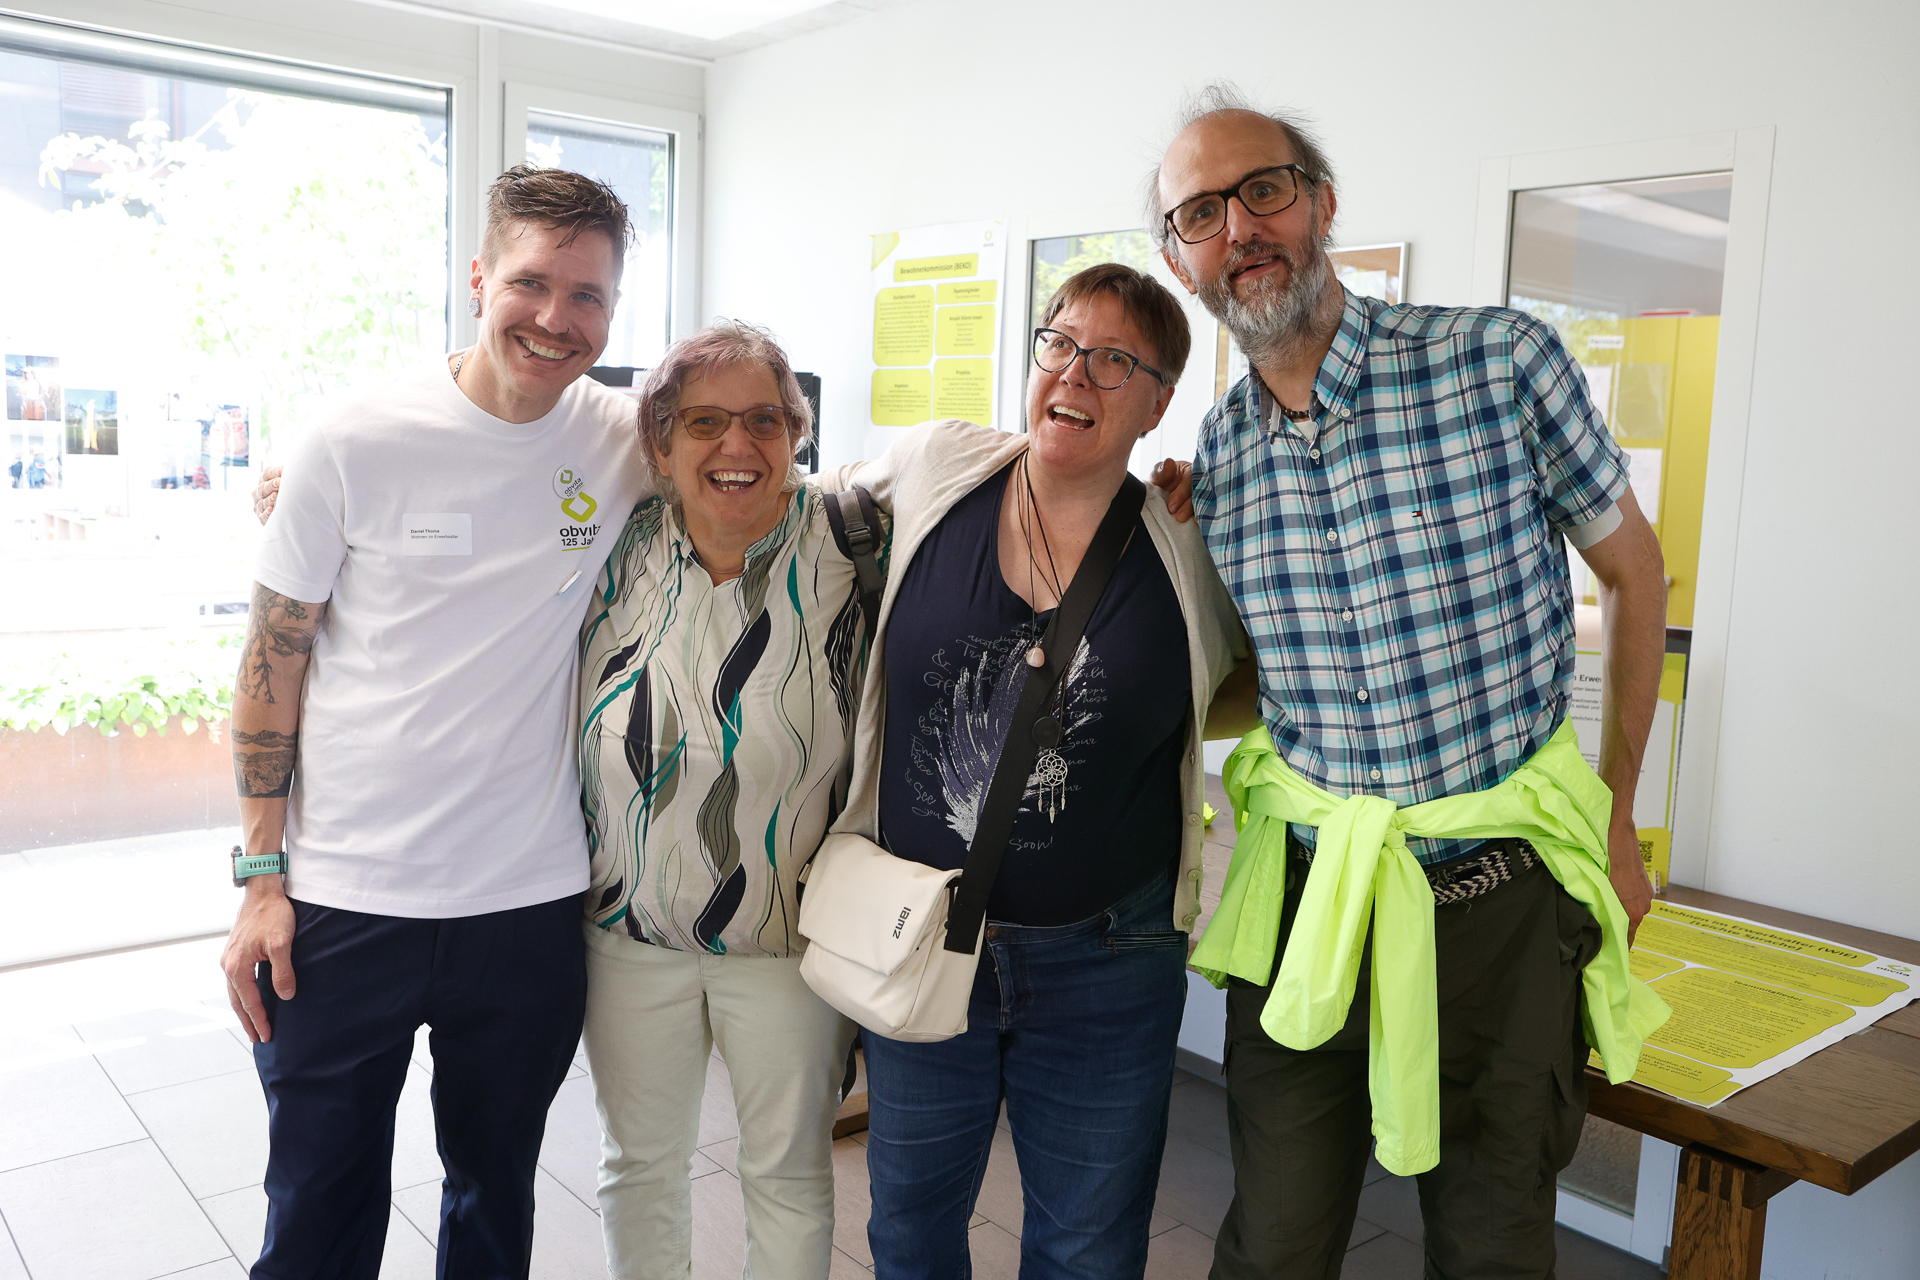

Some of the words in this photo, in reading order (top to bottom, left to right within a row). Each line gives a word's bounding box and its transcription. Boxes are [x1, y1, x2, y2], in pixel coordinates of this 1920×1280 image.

[564, 477, 582, 495] obvita
[561, 538, 578, 547] 125
[1659, 907, 1709, 922] Wohnen
[1731, 925, 1816, 947] Erwerbsalter
[1818, 946, 1858, 960] (WIE)
[1876, 966, 1910, 977] obvita
[1734, 980, 1804, 1002] Teammitglieder
